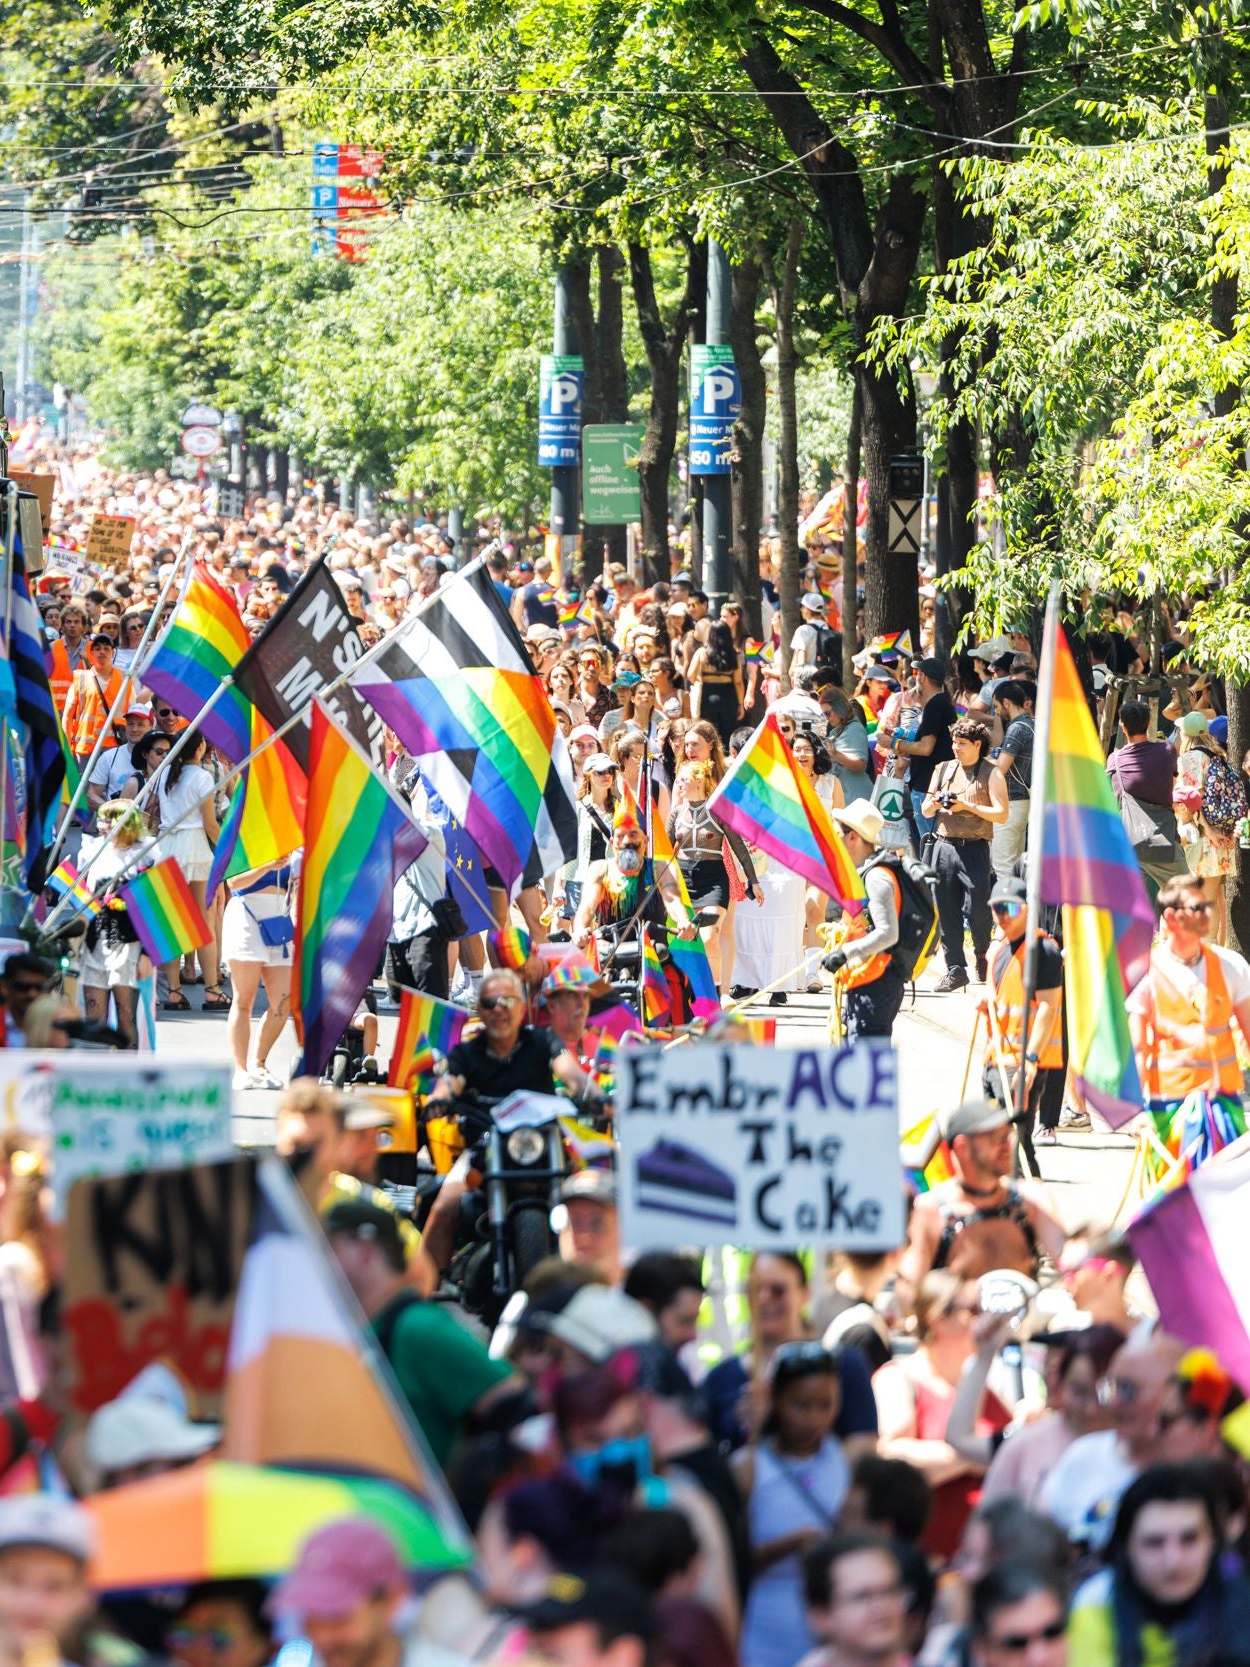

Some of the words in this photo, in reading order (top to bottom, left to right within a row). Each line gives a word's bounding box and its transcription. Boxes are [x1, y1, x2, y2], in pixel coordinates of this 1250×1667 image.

[551, 381, 578, 414] P
[703, 375, 735, 414] P
[589, 464, 612, 474] Auch
[589, 475, 619, 484] offline
[626, 1048, 894, 1112] EmbrACE
[738, 1118, 843, 1167] The
